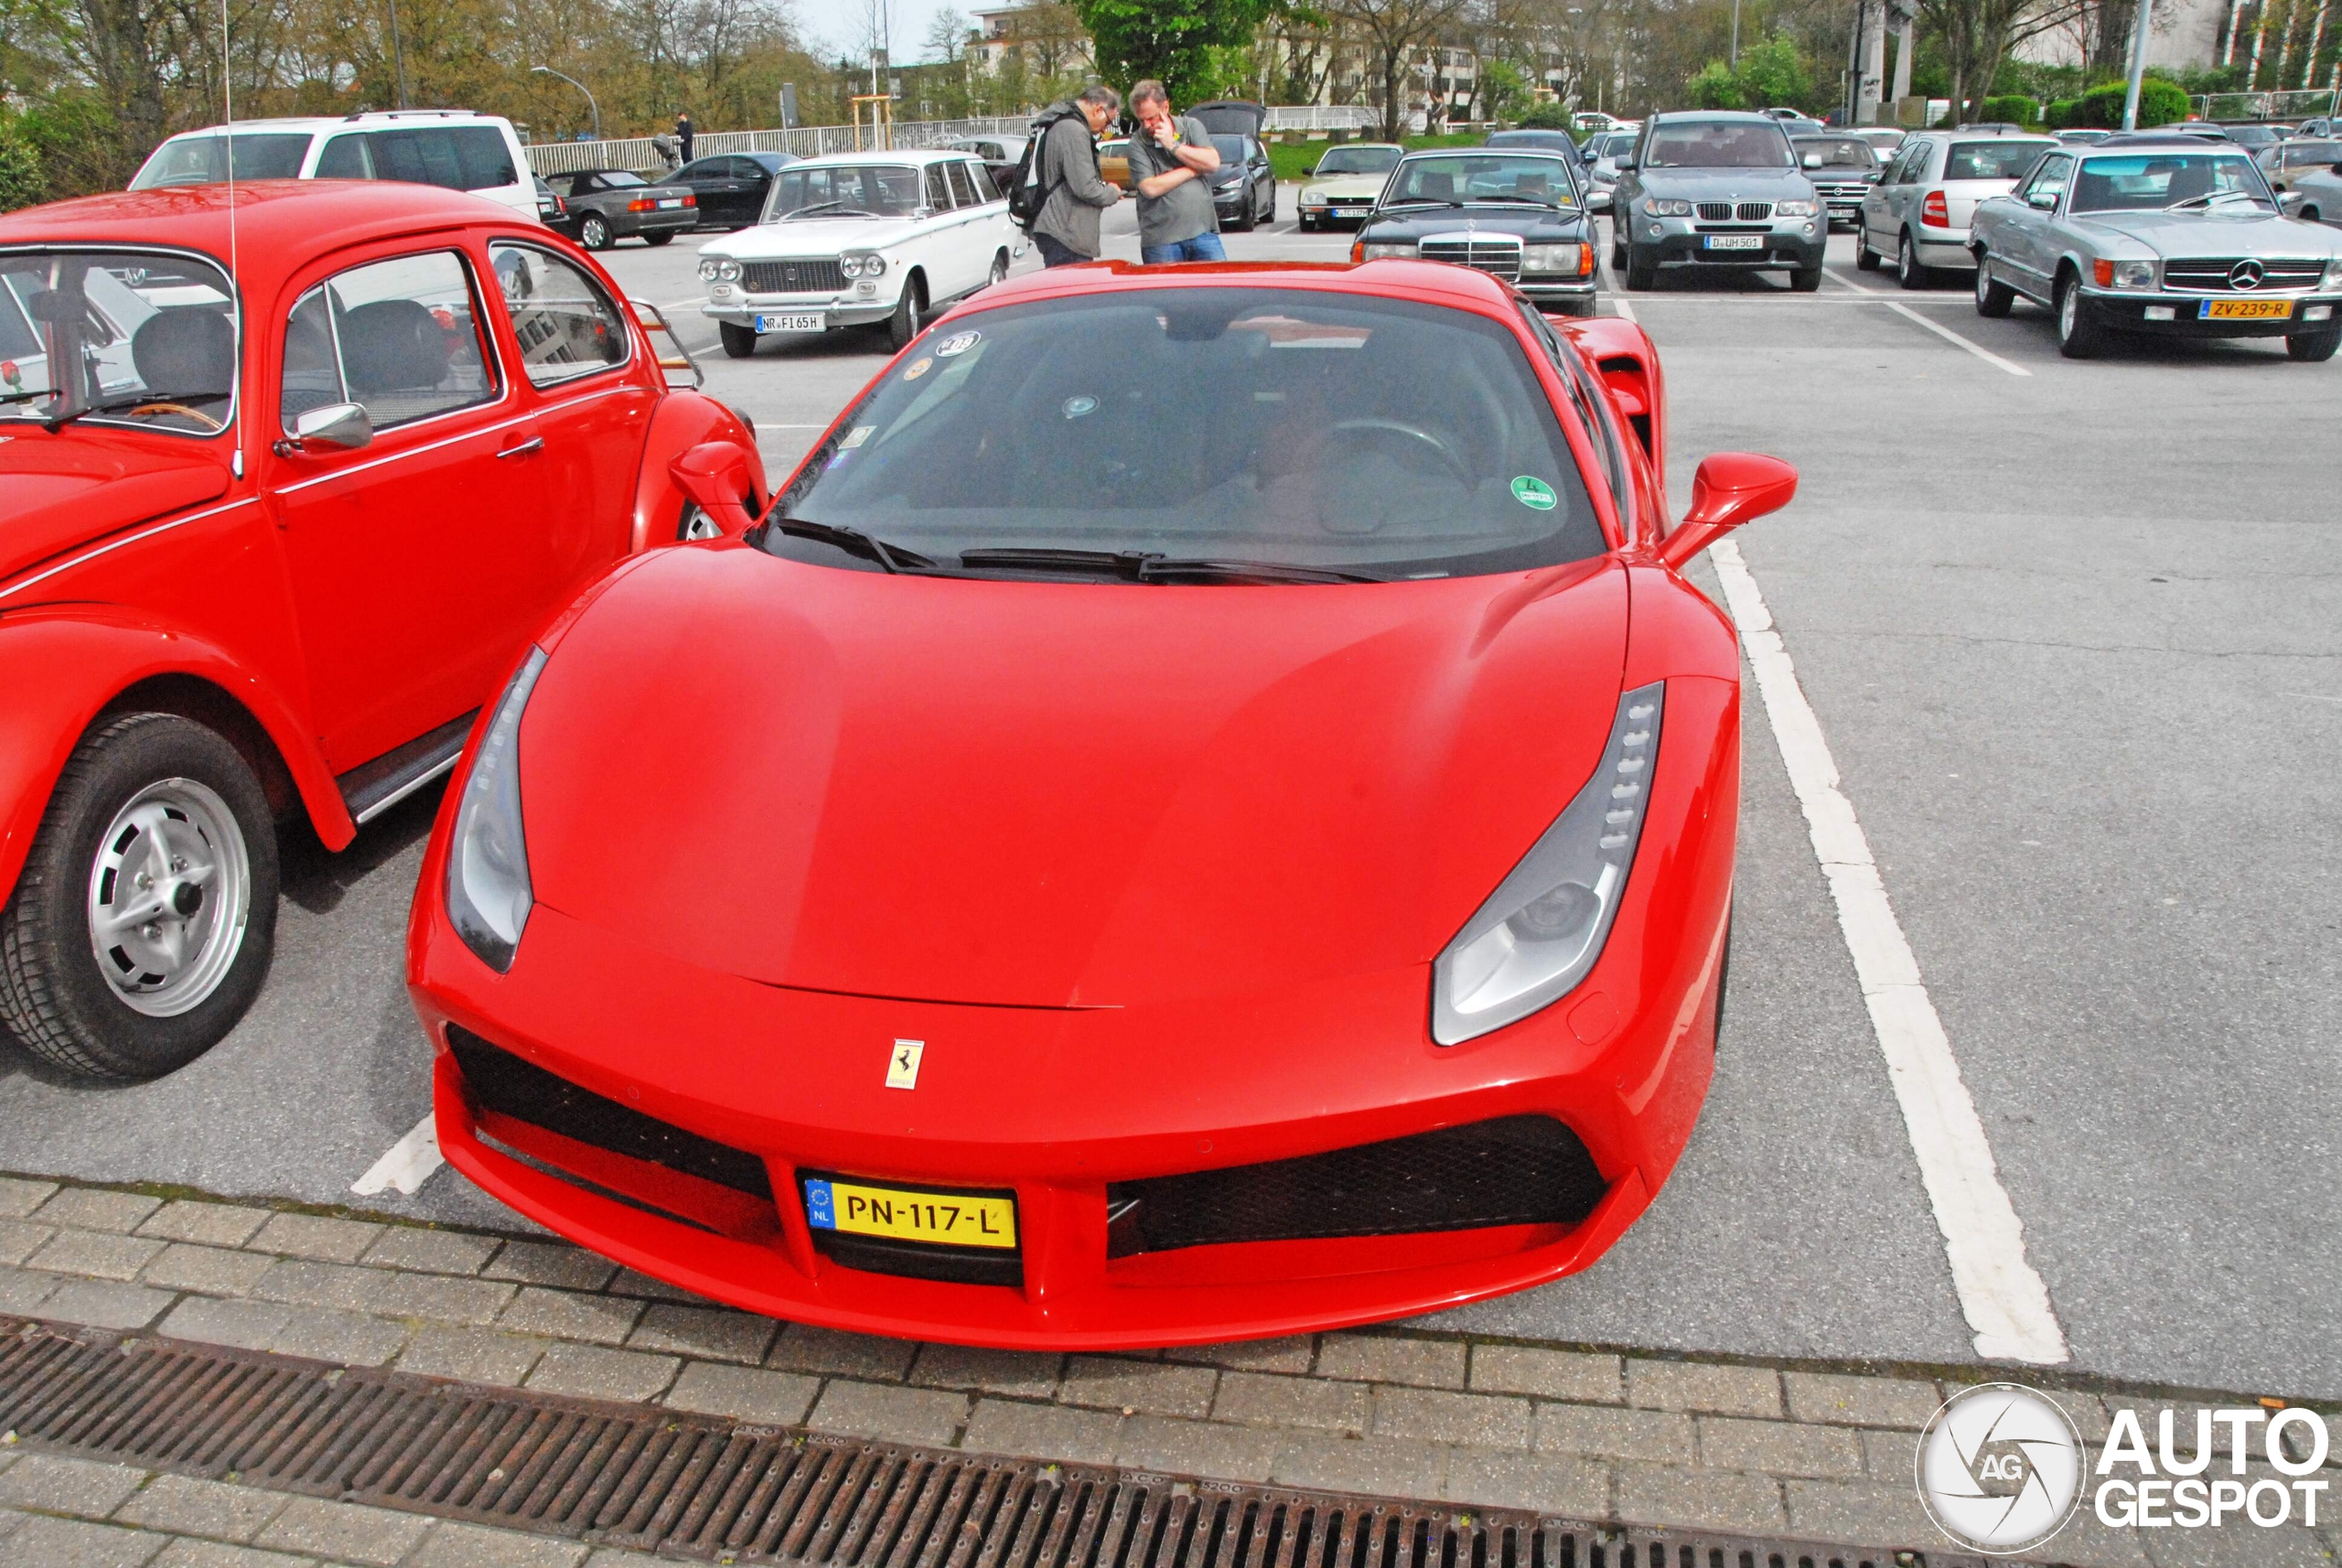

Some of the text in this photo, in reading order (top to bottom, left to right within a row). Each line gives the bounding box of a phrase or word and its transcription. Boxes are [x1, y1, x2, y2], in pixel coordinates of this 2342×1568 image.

[1713, 238, 1757, 248] D UH 501
[2213, 303, 2283, 316] ZV-239-R
[763, 317, 775, 329] NR
[1526, 478, 1539, 492] 4
[814, 1210, 829, 1221] NL
[847, 1195, 1000, 1234] PN-117-L
[1121, 1472, 1165, 1484] ACO
